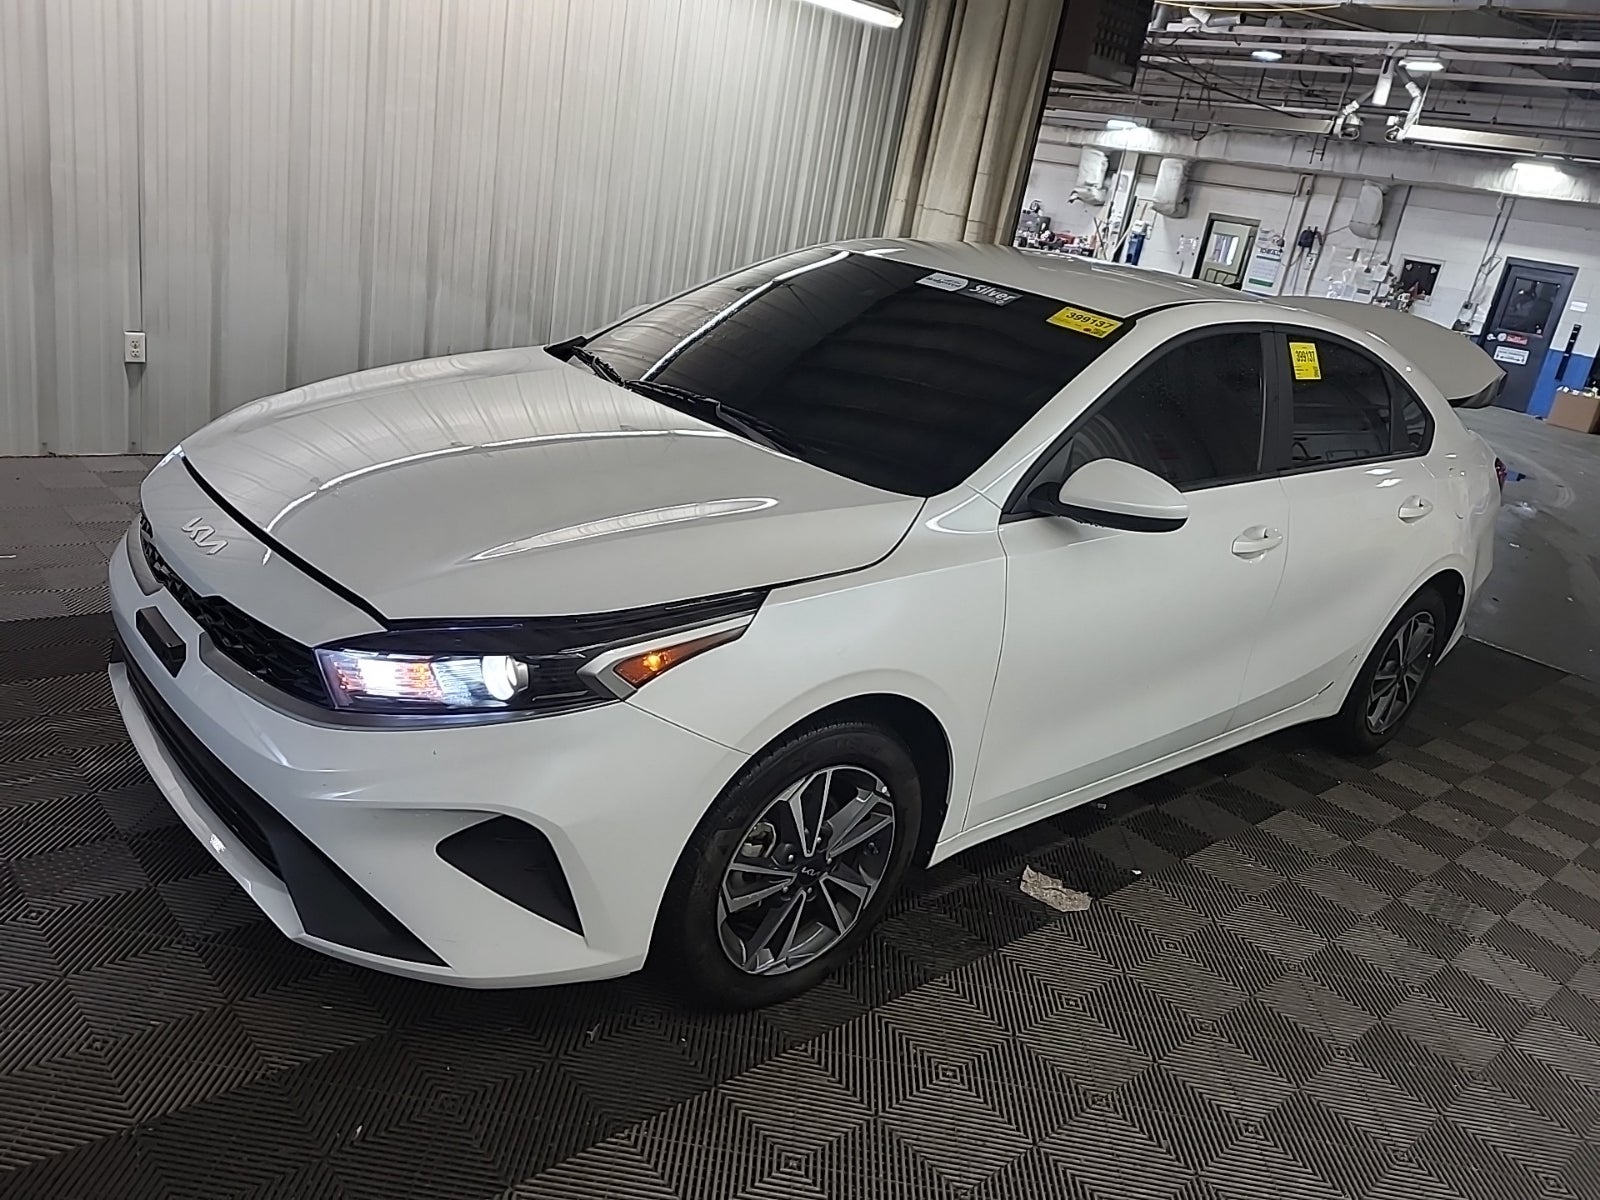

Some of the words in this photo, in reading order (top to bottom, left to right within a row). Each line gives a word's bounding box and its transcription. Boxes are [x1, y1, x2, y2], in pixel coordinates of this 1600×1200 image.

[969, 284, 1016, 300] Silver
[1065, 312, 1114, 328] 399137
[1295, 350, 1316, 362] 399137
[181, 517, 228, 555] KIA
